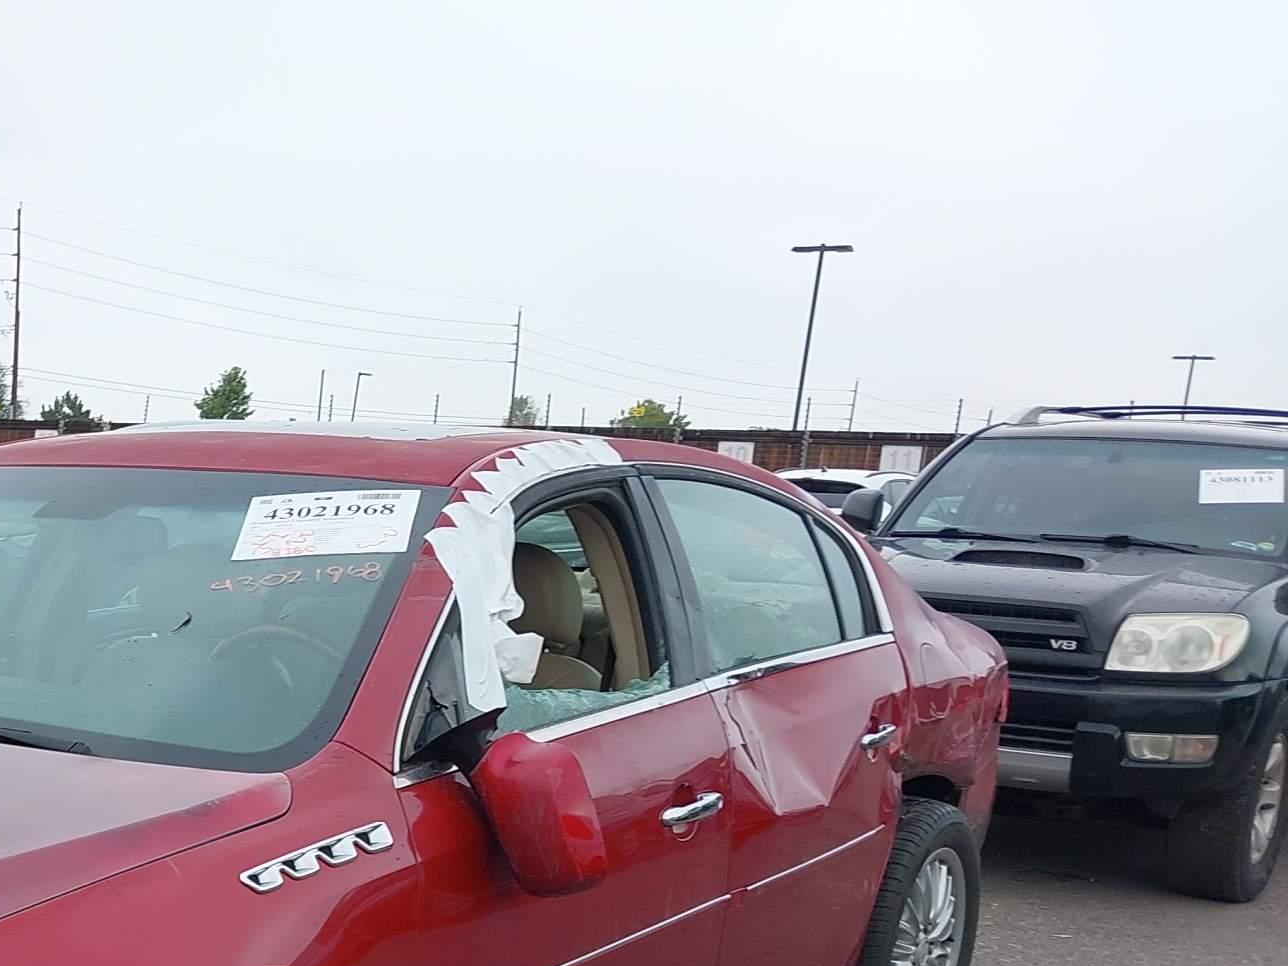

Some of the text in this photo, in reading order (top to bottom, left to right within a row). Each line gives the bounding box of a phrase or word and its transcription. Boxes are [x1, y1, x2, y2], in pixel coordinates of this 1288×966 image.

[264, 503, 396, 520] 43021968
[210, 562, 383, 592] 43021968
[1049, 638, 1078, 651] V8
